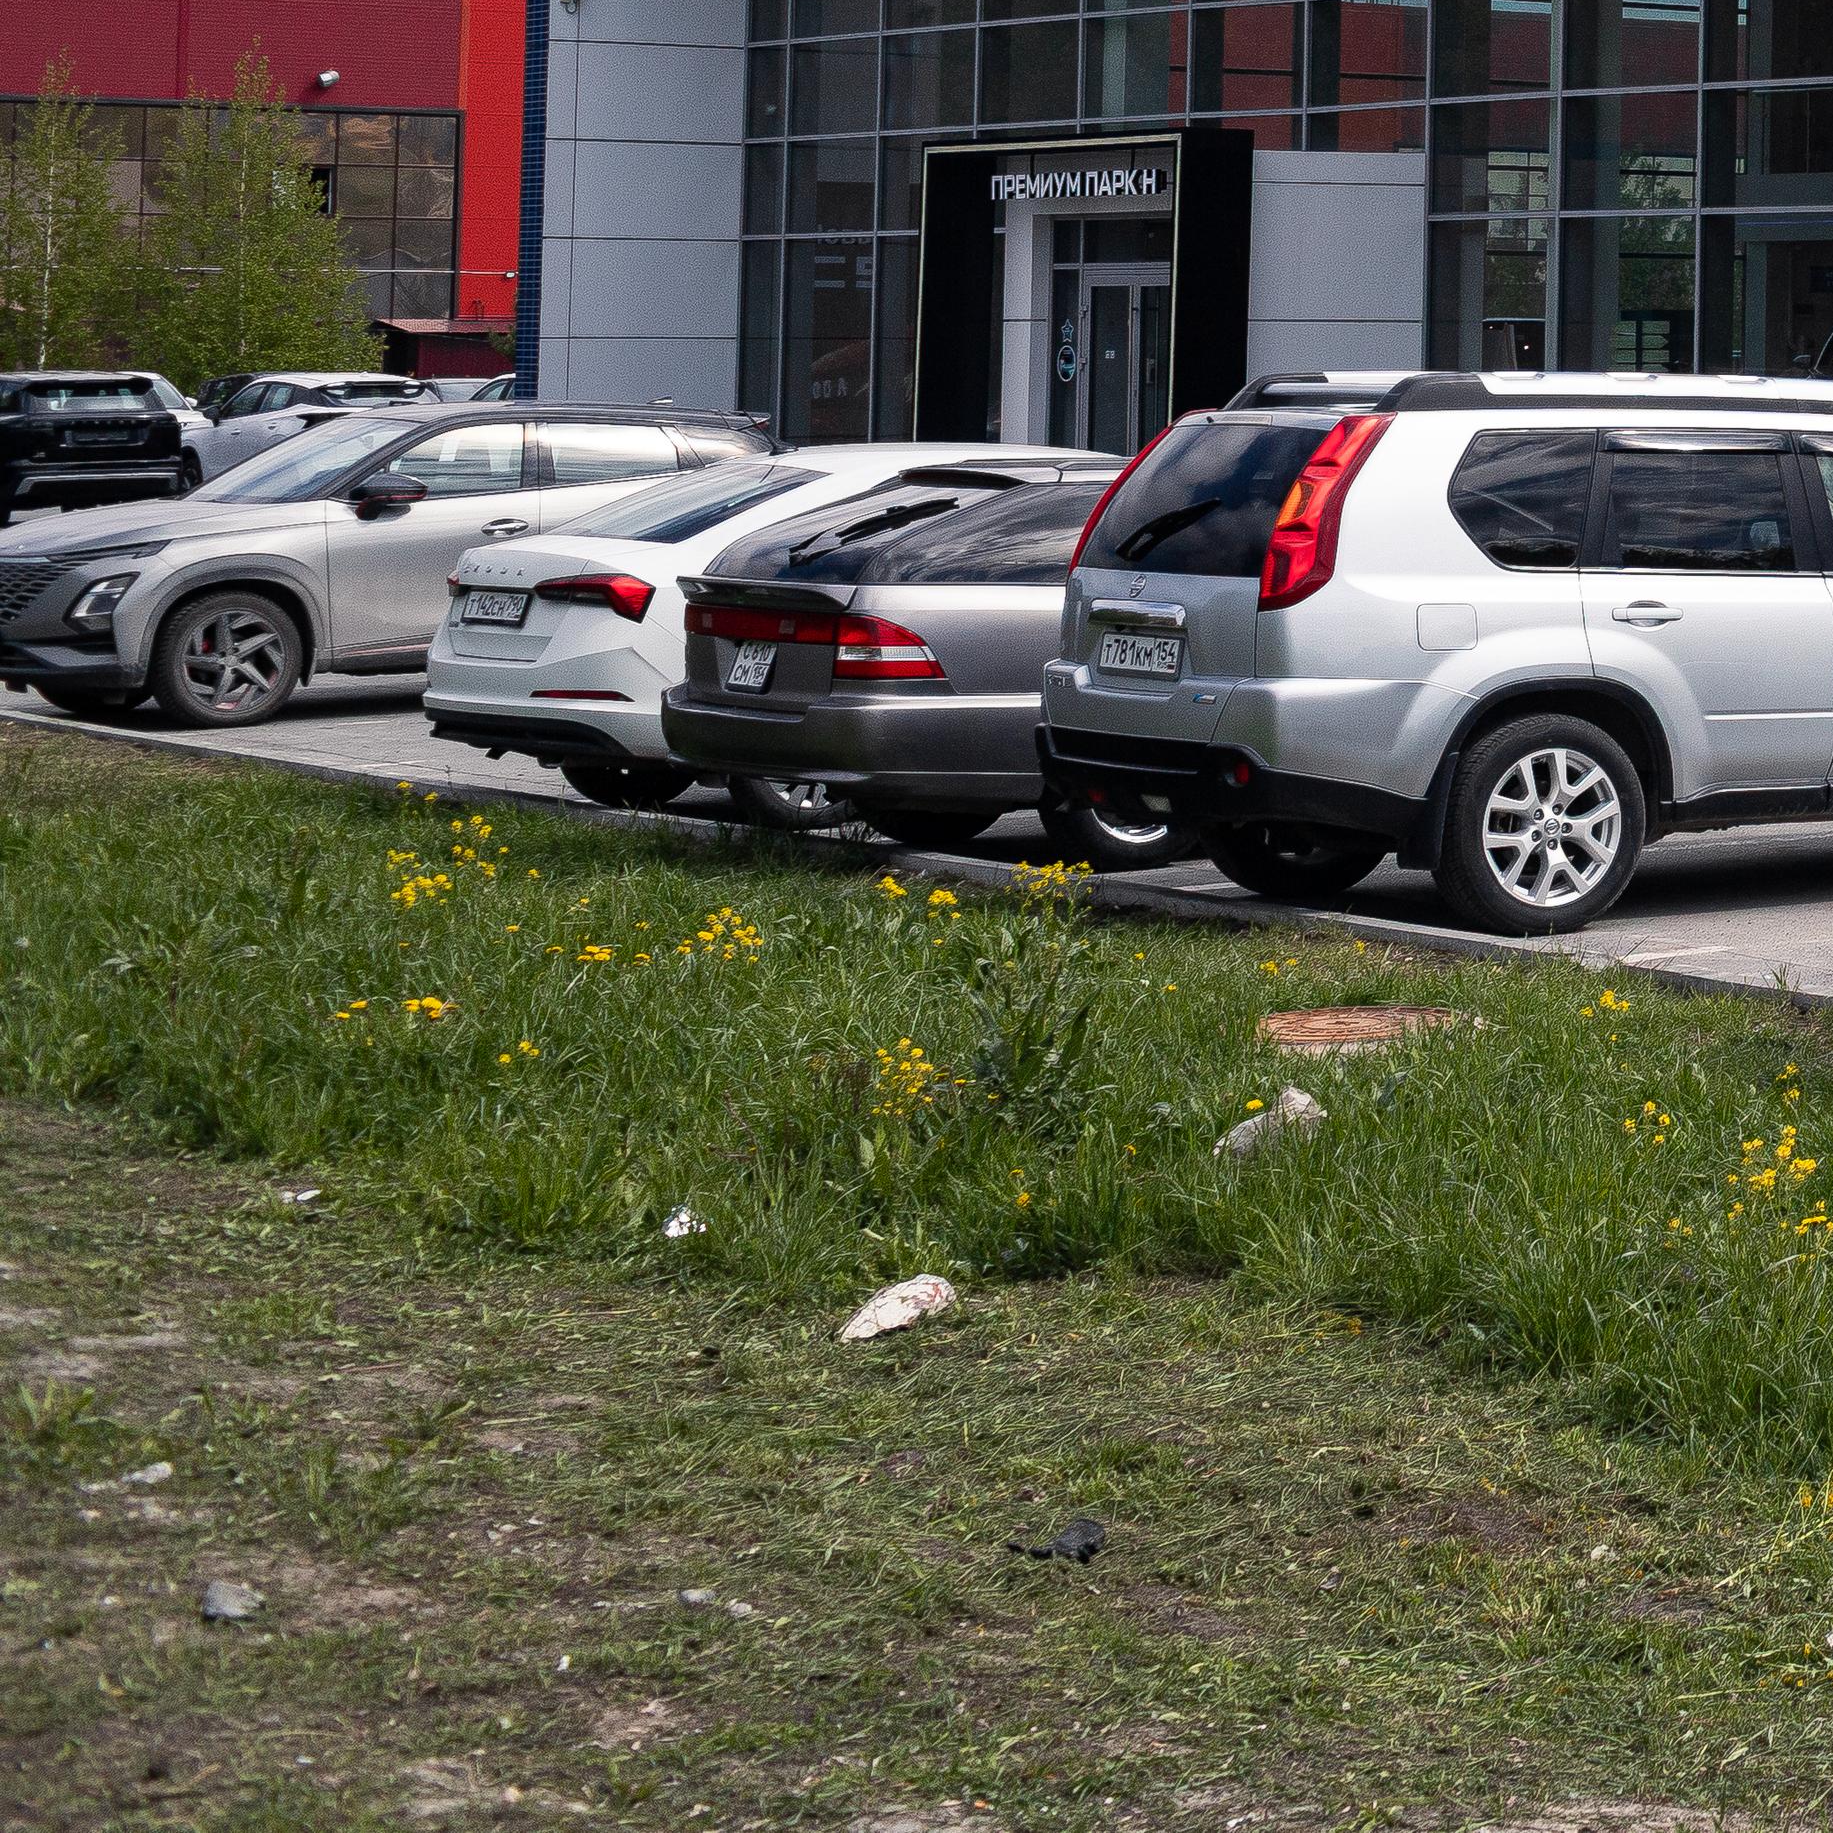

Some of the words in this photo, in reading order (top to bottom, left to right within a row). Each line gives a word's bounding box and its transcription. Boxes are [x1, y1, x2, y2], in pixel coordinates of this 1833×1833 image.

[991, 170, 1081, 201] ПРЕМИУМ
[1085, 168, 1138, 197] ПАРК
[1103, 638, 1154, 668] Т781КМ
[1154, 640, 1176, 664] 154
[733, 664, 752, 682] СМ
